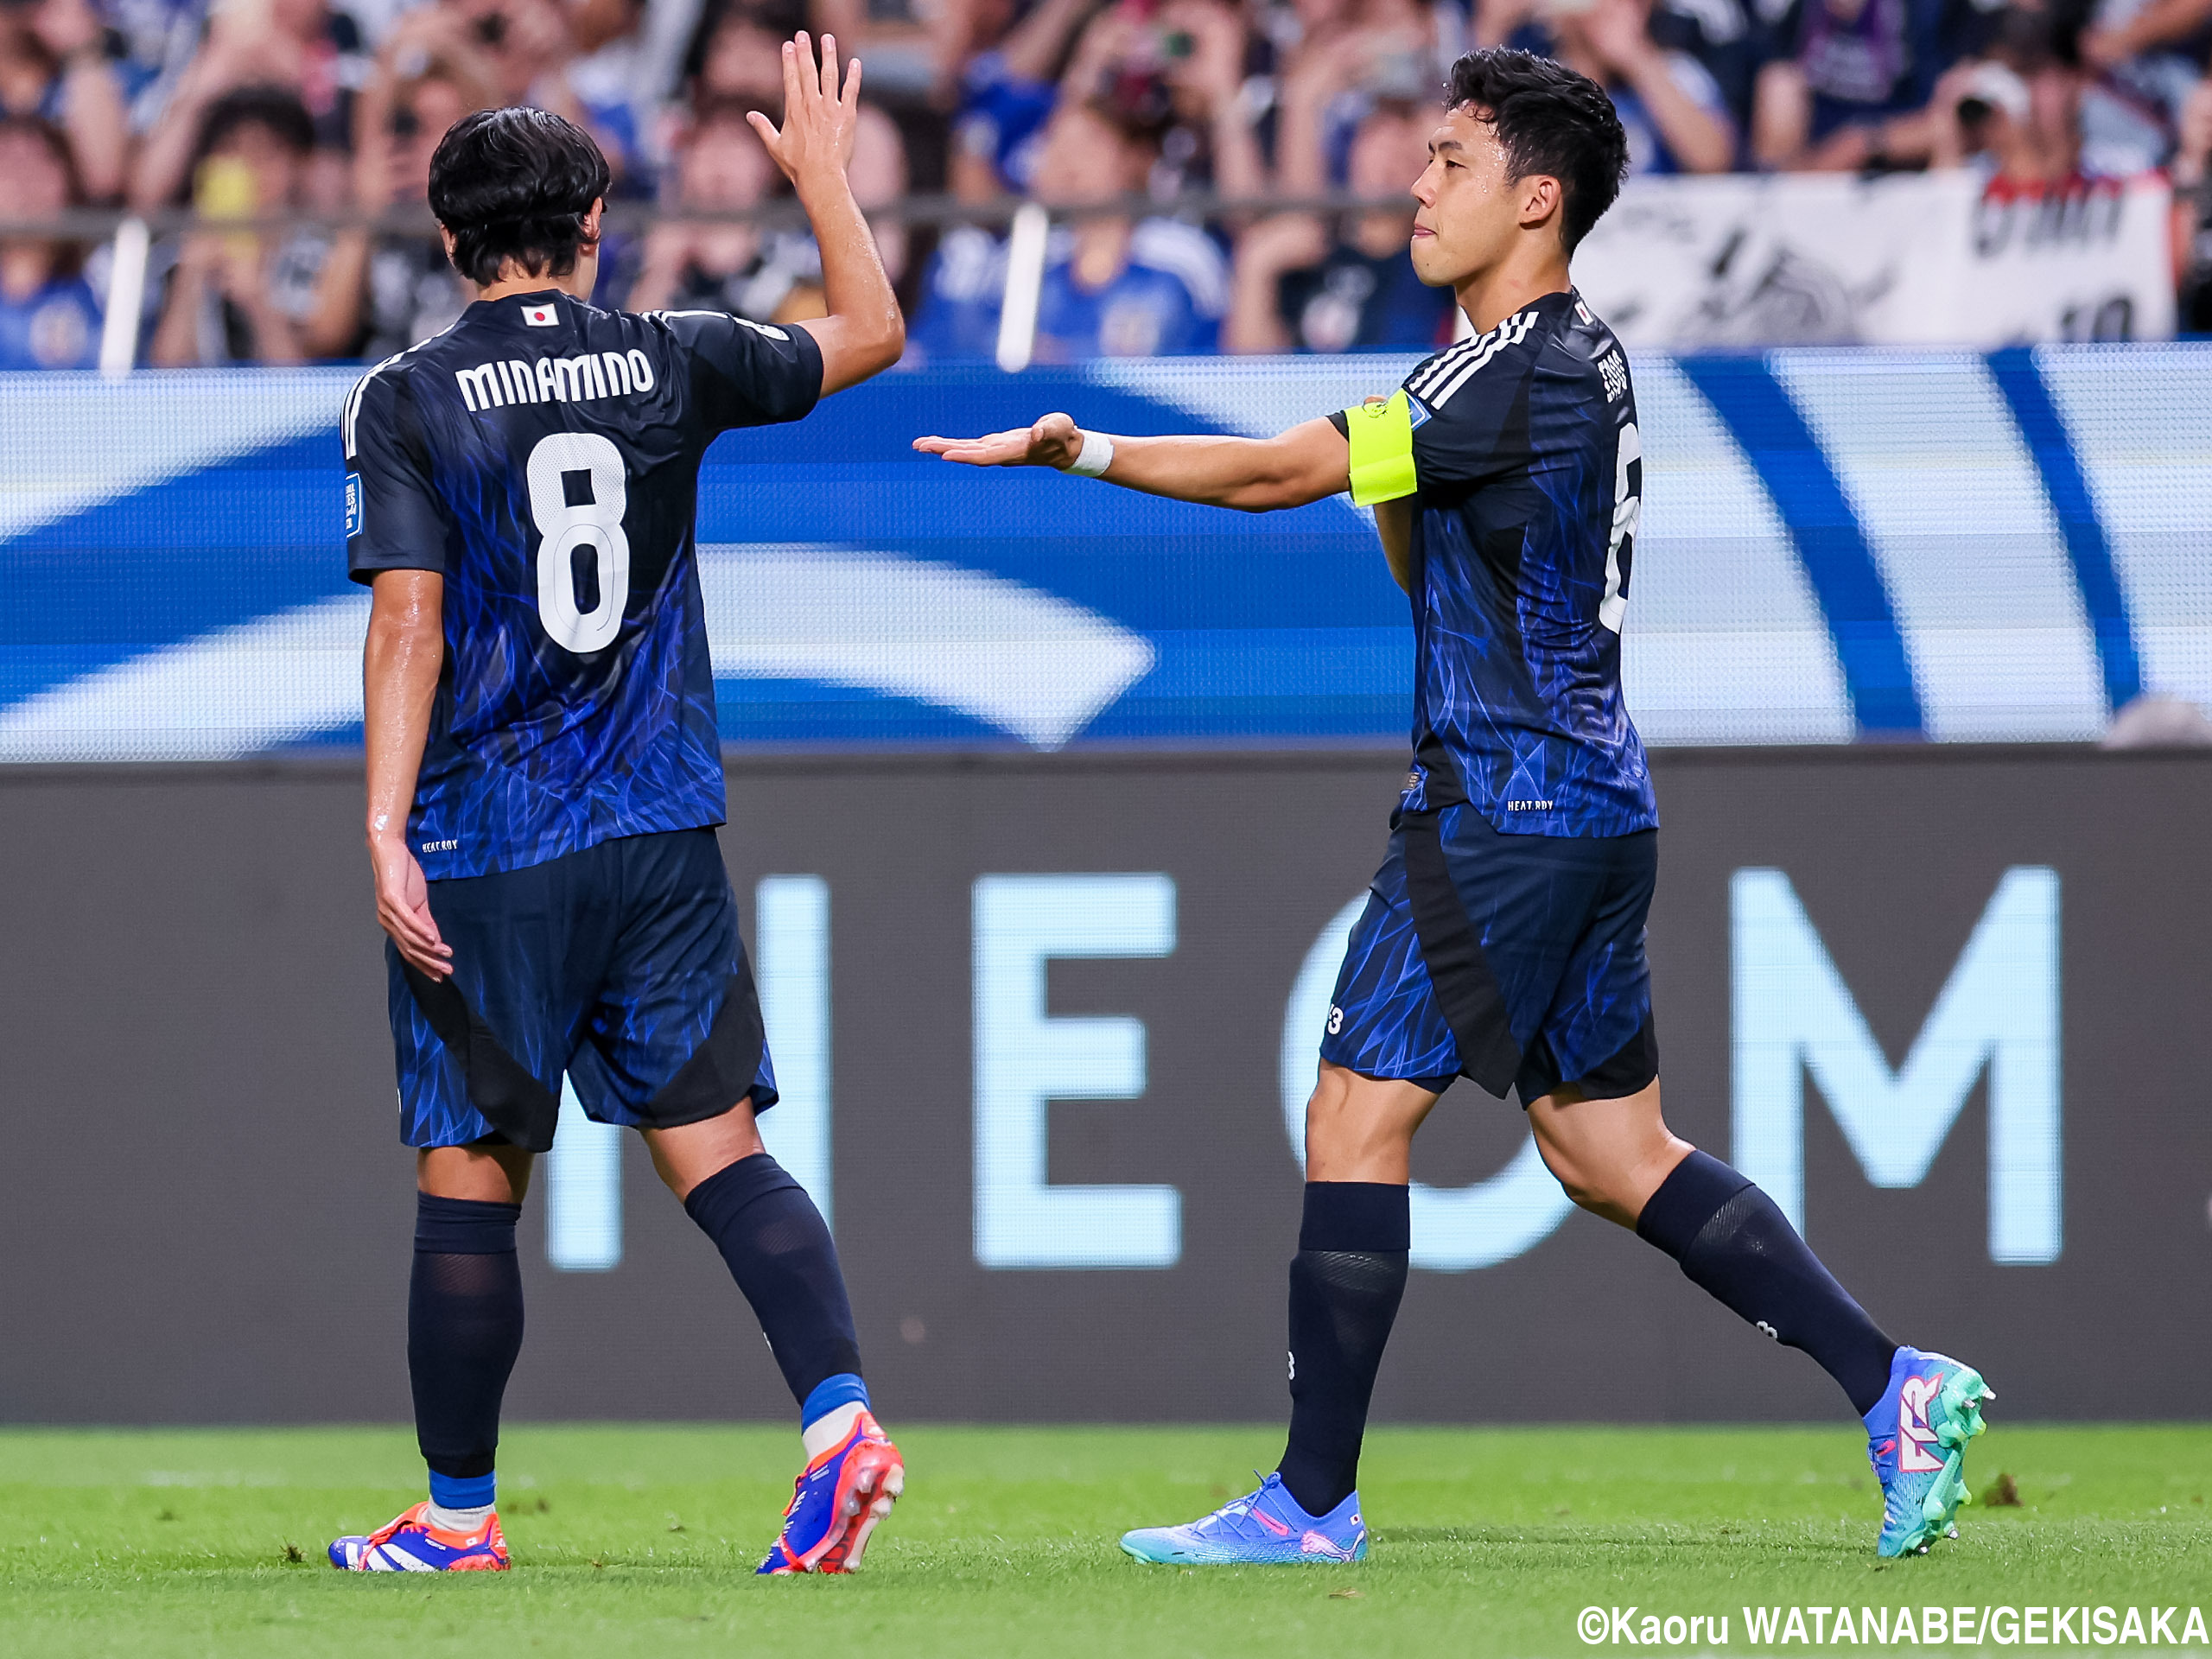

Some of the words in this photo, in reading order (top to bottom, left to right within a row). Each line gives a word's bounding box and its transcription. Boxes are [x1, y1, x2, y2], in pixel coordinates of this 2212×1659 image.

[455, 349, 654, 412] MINAMINO
[526, 432, 630, 653] 8
[1508, 800, 1553, 811] HEAT.RDY
